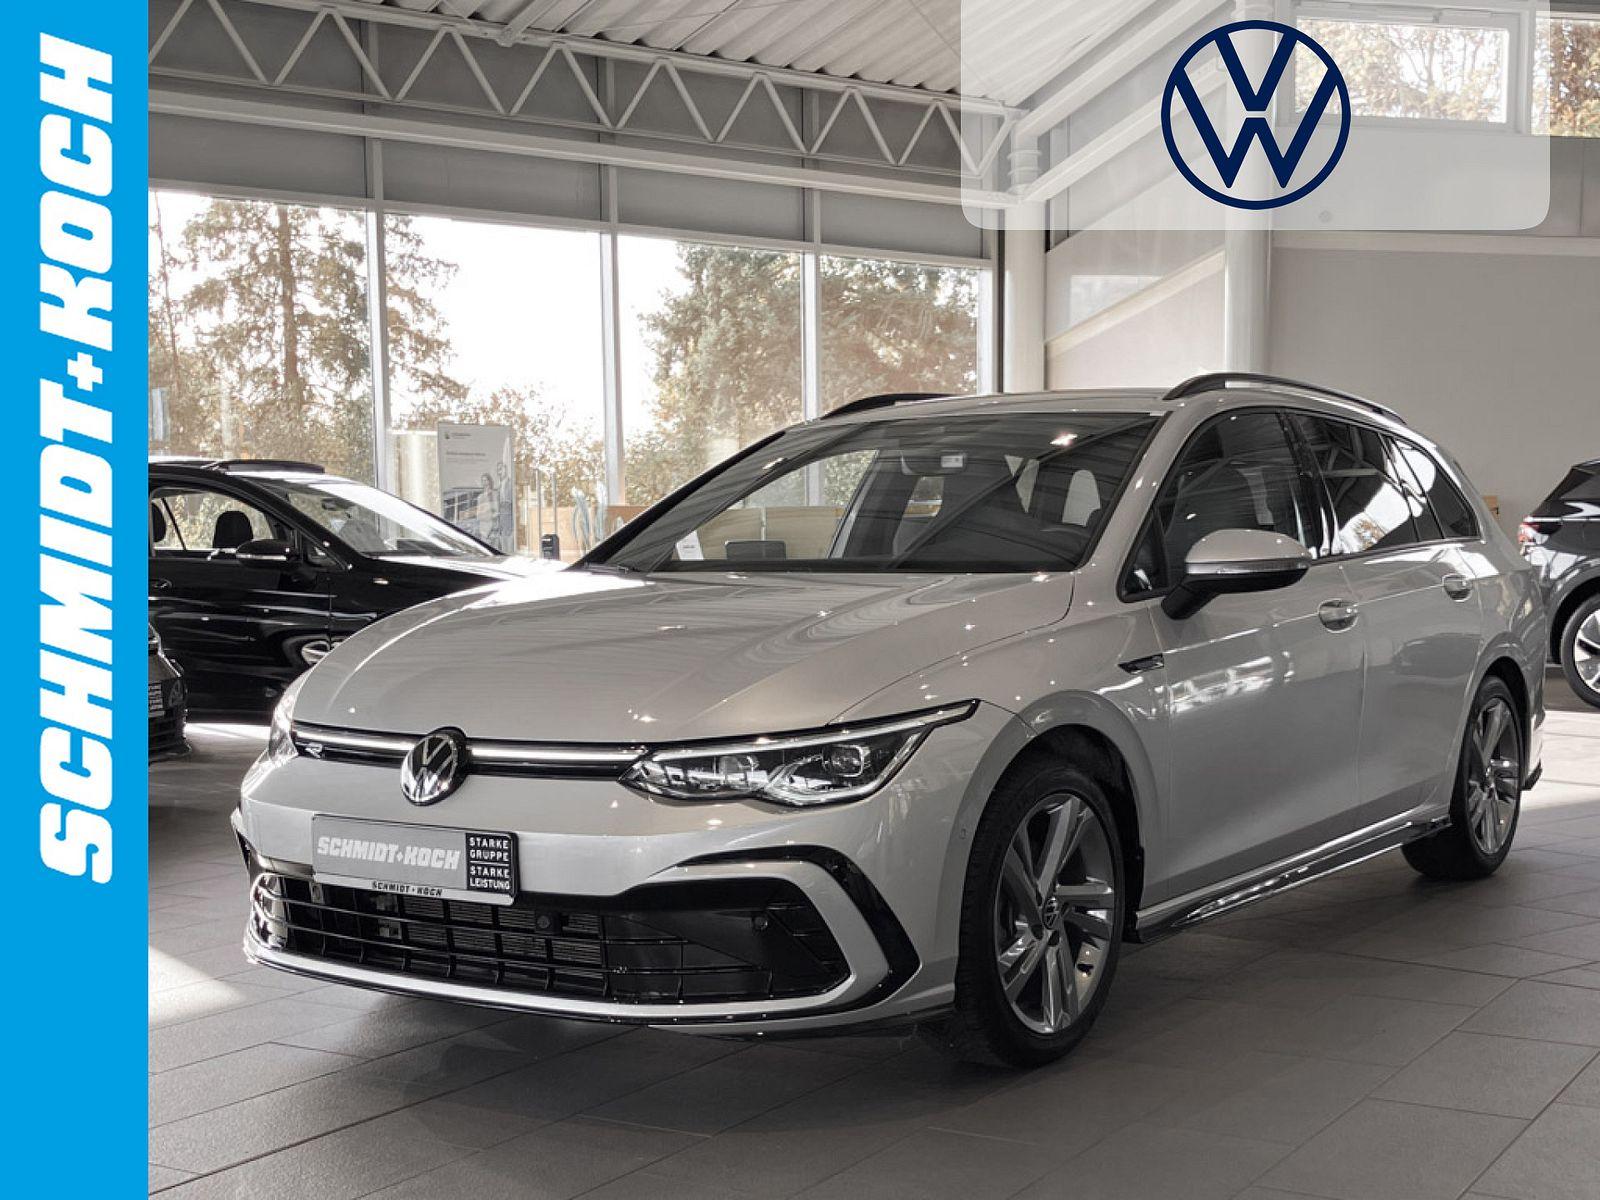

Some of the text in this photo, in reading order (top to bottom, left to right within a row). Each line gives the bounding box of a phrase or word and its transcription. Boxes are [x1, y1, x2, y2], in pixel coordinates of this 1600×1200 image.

[469, 836, 509, 849] STARKE
[469, 849, 509, 862] GRUPPE
[469, 865, 510, 879] STARKE
[469, 877, 510, 890] LEISTUNG
